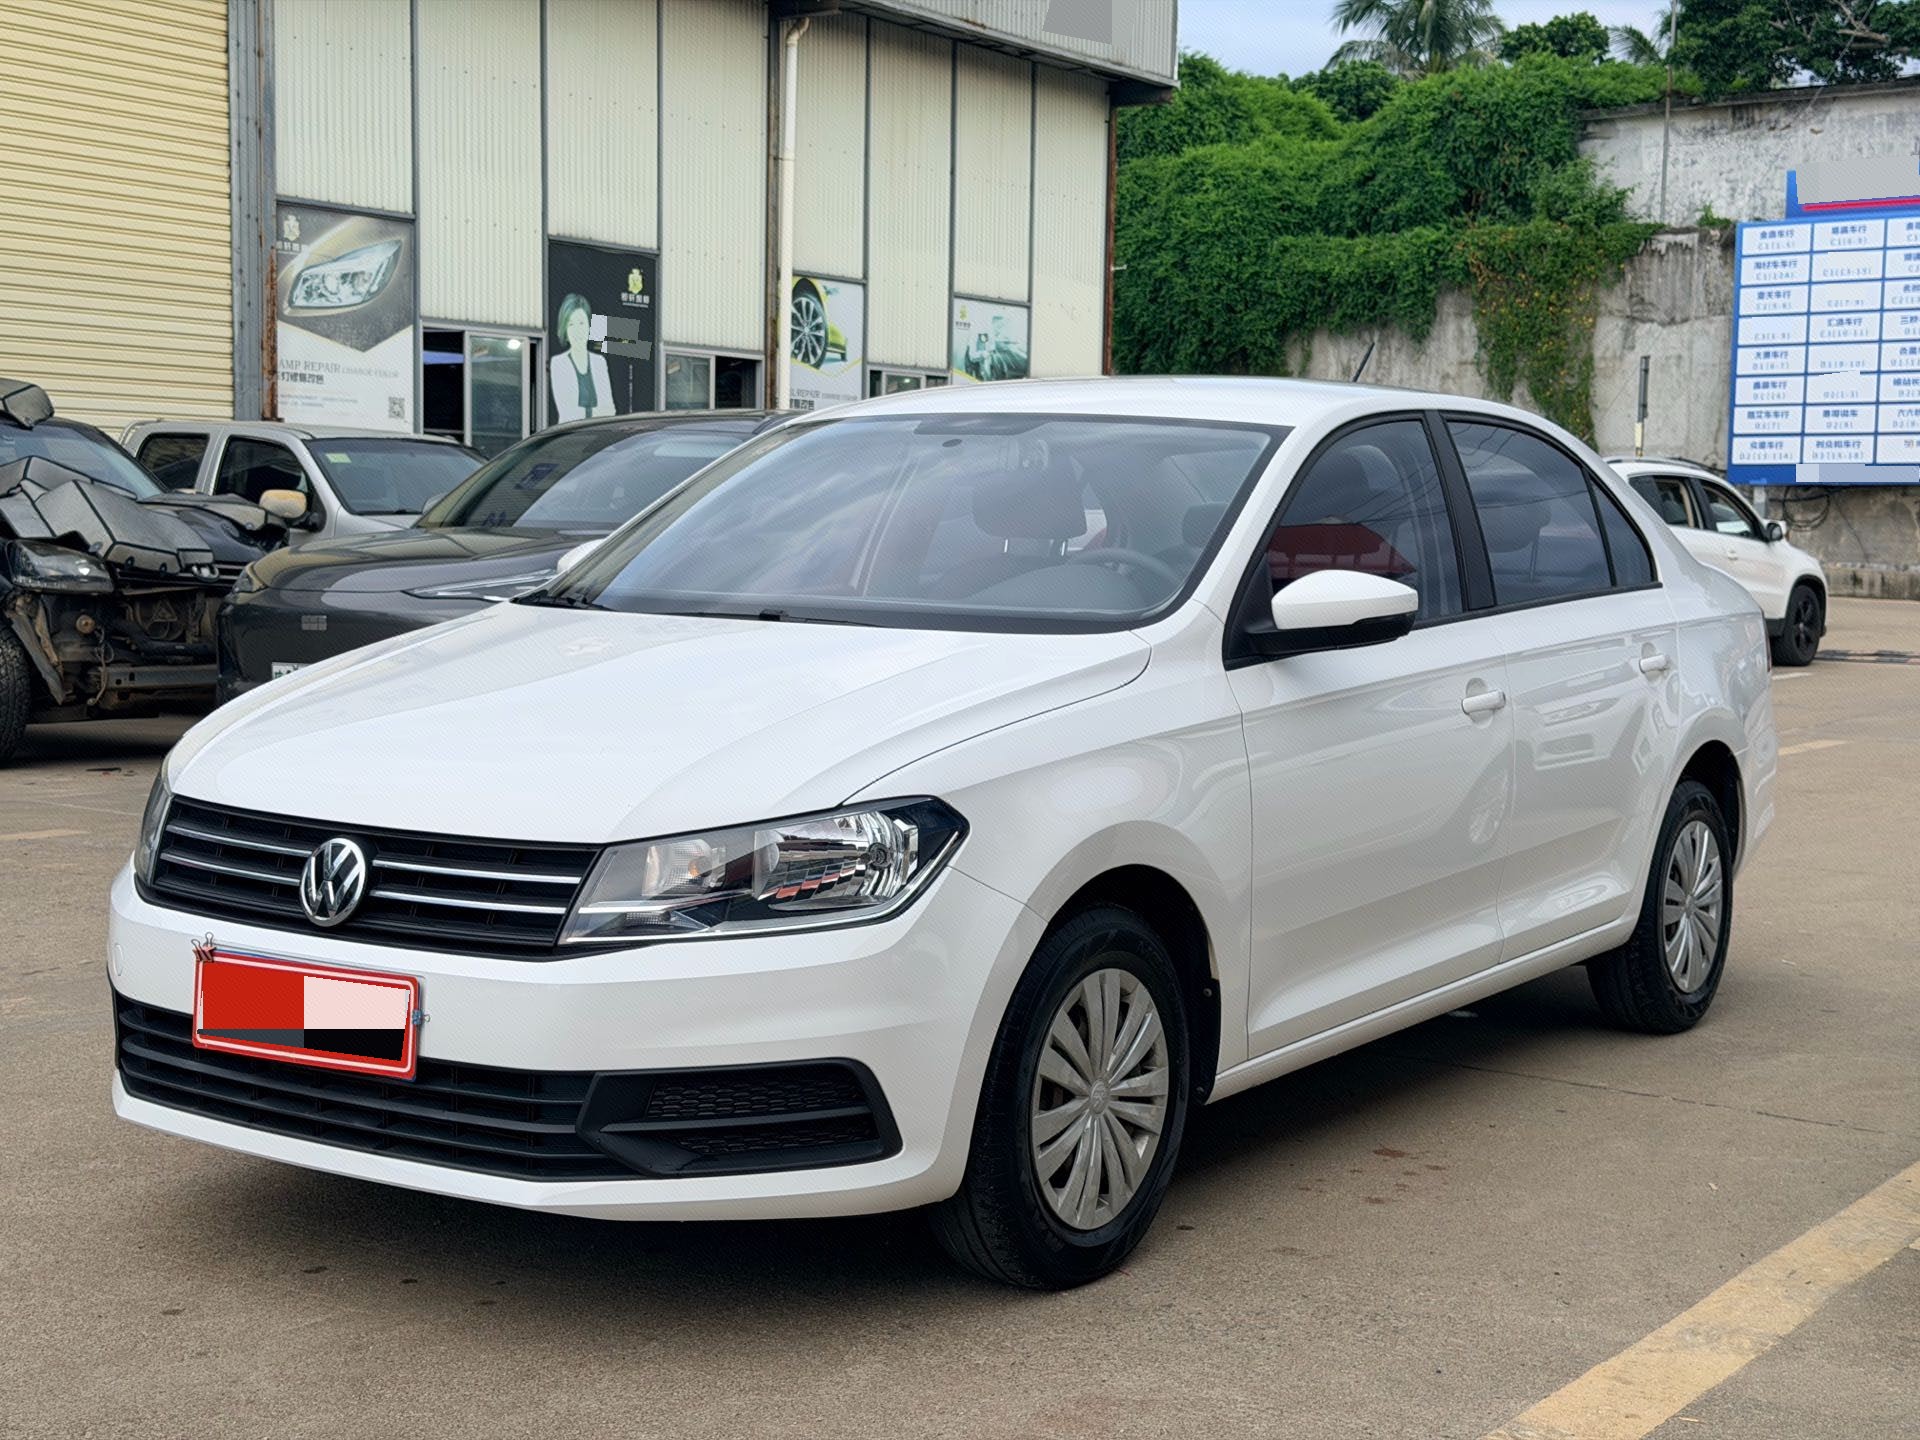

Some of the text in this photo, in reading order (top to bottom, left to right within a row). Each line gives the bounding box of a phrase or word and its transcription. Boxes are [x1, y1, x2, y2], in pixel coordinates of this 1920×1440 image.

[1831, 224, 1867, 236] 车行
[303, 360, 341, 374] REPAIR
[1752, 381, 1788, 391] 车行
[1750, 440, 1784, 450] 车行
